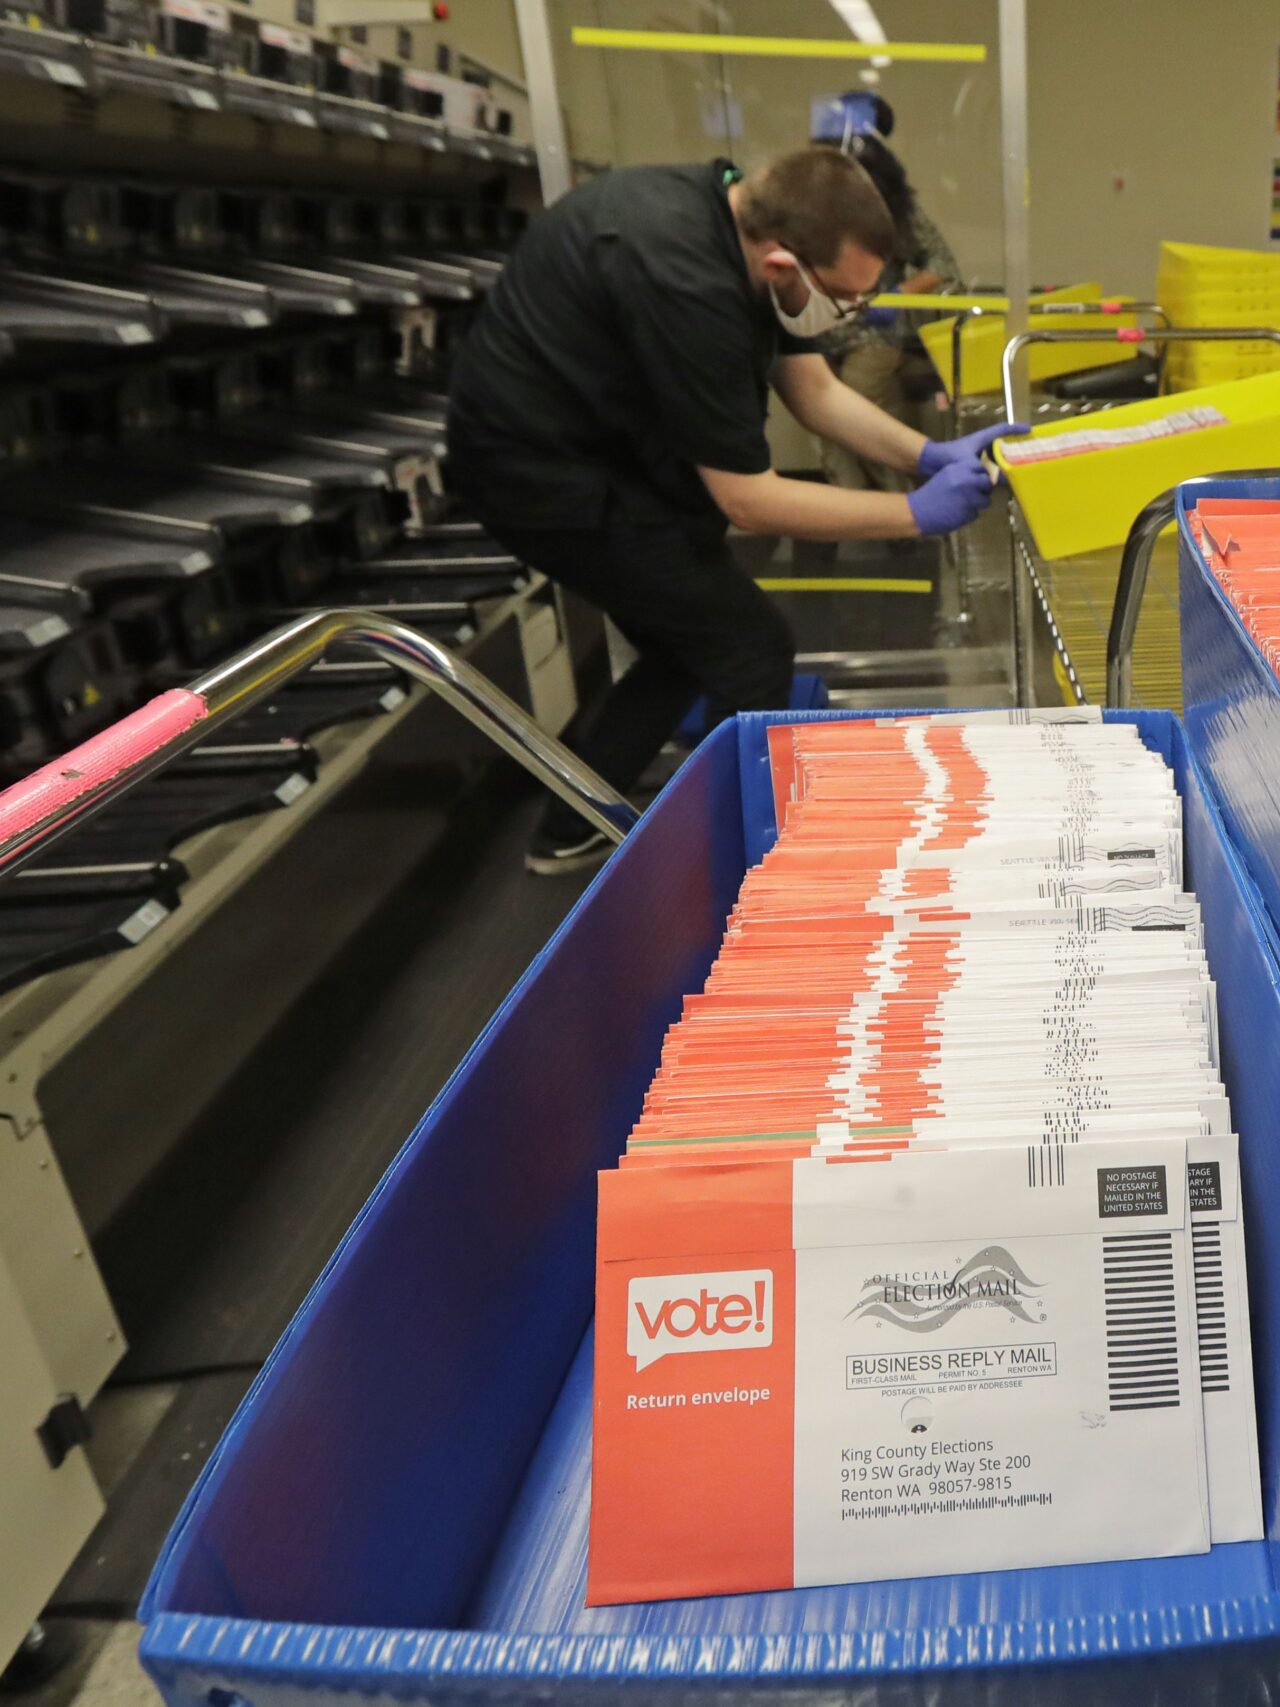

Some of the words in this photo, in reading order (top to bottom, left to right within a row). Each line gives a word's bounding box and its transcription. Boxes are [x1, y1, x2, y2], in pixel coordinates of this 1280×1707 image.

[1106, 1182, 1150, 1192] NECESSARY
[1107, 1174, 1119, 1182] NO
[1121, 1172, 1157, 1181] POSTAGE
[1104, 1193, 1134, 1202] MAILED
[1135, 1193, 1144, 1201] IN
[1146, 1192, 1161, 1200] THE
[1190, 1188, 1198, 1196] IN
[1200, 1188, 1215, 1196] THE
[1104, 1203, 1133, 1213] UNITED
[1135, 1202, 1163, 1211] STATES
[872, 1270, 949, 1284] OFFICIAL
[884, 1283, 971, 1304] ELECTION
[977, 1278, 1022, 1298] MAIL
[634, 1280, 766, 1340] vote!
[852, 1354, 942, 1375] BUSINESS
[948, 1350, 1005, 1369] REPLY
[1010, 1348, 1052, 1364] MAIL
[851, 1376, 898, 1385] FIRST-CLASS
[900, 1374, 917, 1382] MAIL
[939, 1371, 965, 1379] PERMIT
[1007, 1365, 1038, 1374] RENTON
[1040, 1364, 1052, 1372] WA
[627, 1393, 686, 1410] Return
[692, 1387, 770, 1406] envelope
[881, 1387, 917, 1397] POSTAGE
[918, 1386, 936, 1395] WILL
[938, 1385, 947, 1393] BE
[949, 1384, 966, 1392] PAID
[967, 1383, 978, 1391] BY
[979, 1380, 1023, 1390] ADDRESSEE
[841, 1448, 872, 1464] King
[876, 1444, 927, 1460] County
[931, 1439, 994, 1456] Elections
[841, 1468, 867, 1482] 919
[871, 1466, 894, 1480] SW
[898, 1462, 941, 1479] Grady
[945, 1459, 975, 1475] Way
[979, 1457, 1001, 1472] Ste
[1005, 1455, 1031, 1470] 200
[841, 1487, 893, 1502] Renton
[897, 1483, 921, 1498] WA
[928, 1476, 1012, 1495] 98057-9815
